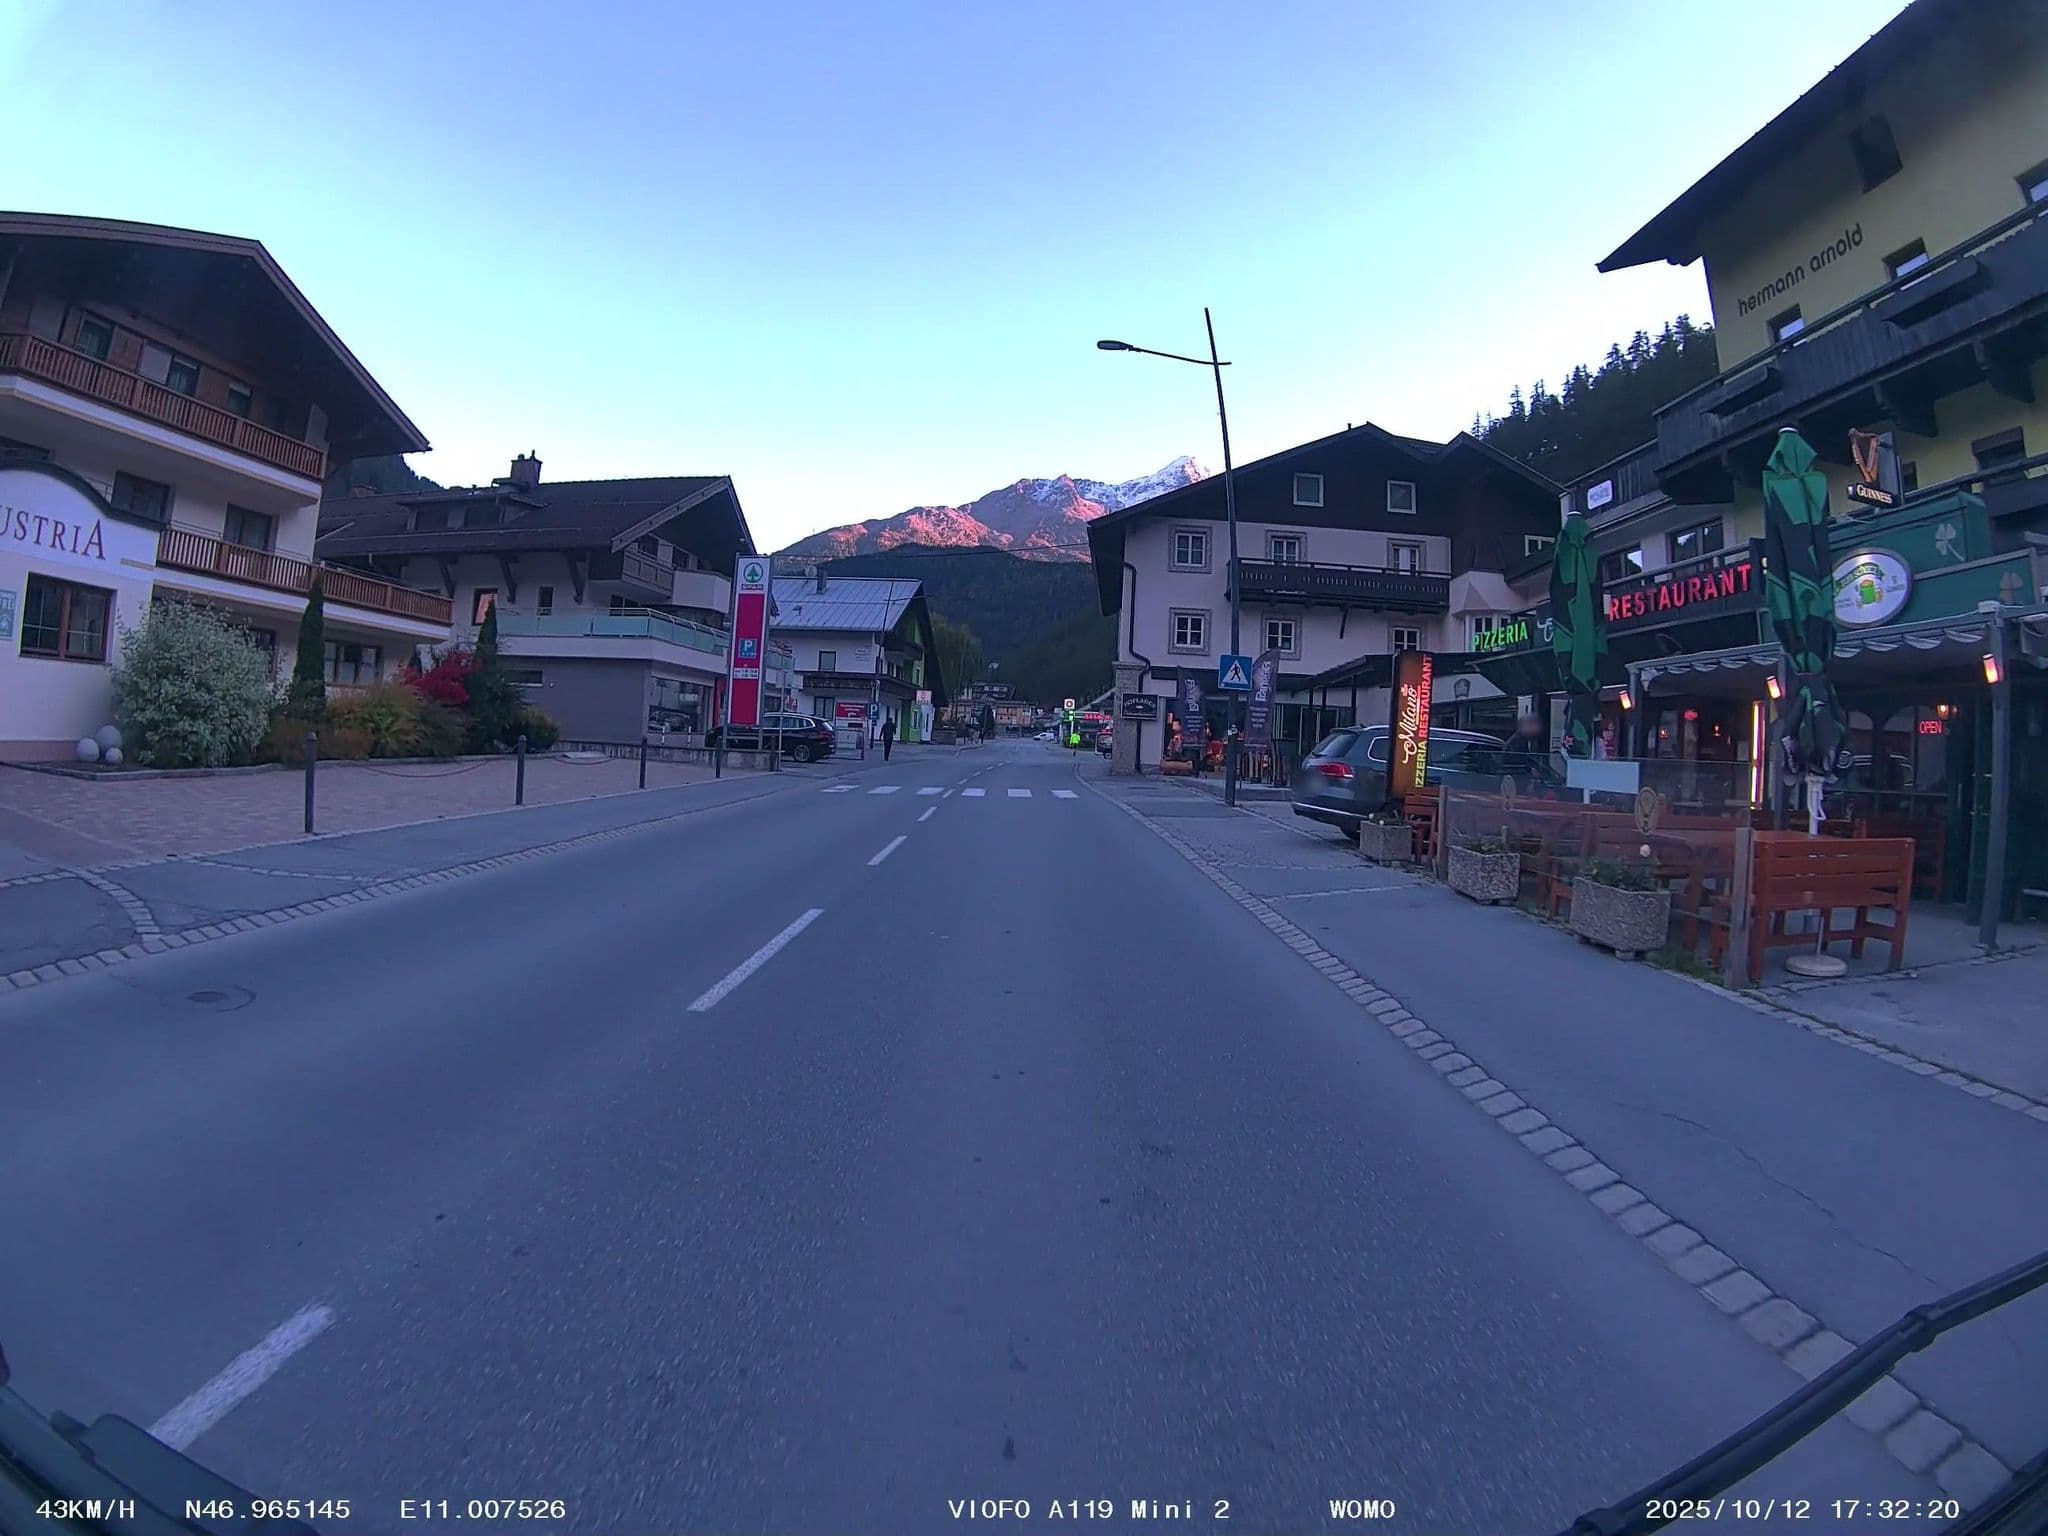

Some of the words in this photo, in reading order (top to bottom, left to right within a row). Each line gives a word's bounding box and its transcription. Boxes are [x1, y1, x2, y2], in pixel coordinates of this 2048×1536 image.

[1738, 265, 1805, 317] hermann
[1809, 222, 1863, 272] arnold
[1608, 564, 1752, 622] RESTAURANT
[1472, 621, 1529, 652] PIZZERIA
[870, 703, 878, 716] P
[1418, 654, 1432, 738] RESTAURANT
[1399, 684, 1418, 764] Milano
[1920, 721, 1942, 734] OPEN
[1415, 741, 1427, 788] IZZERIA
